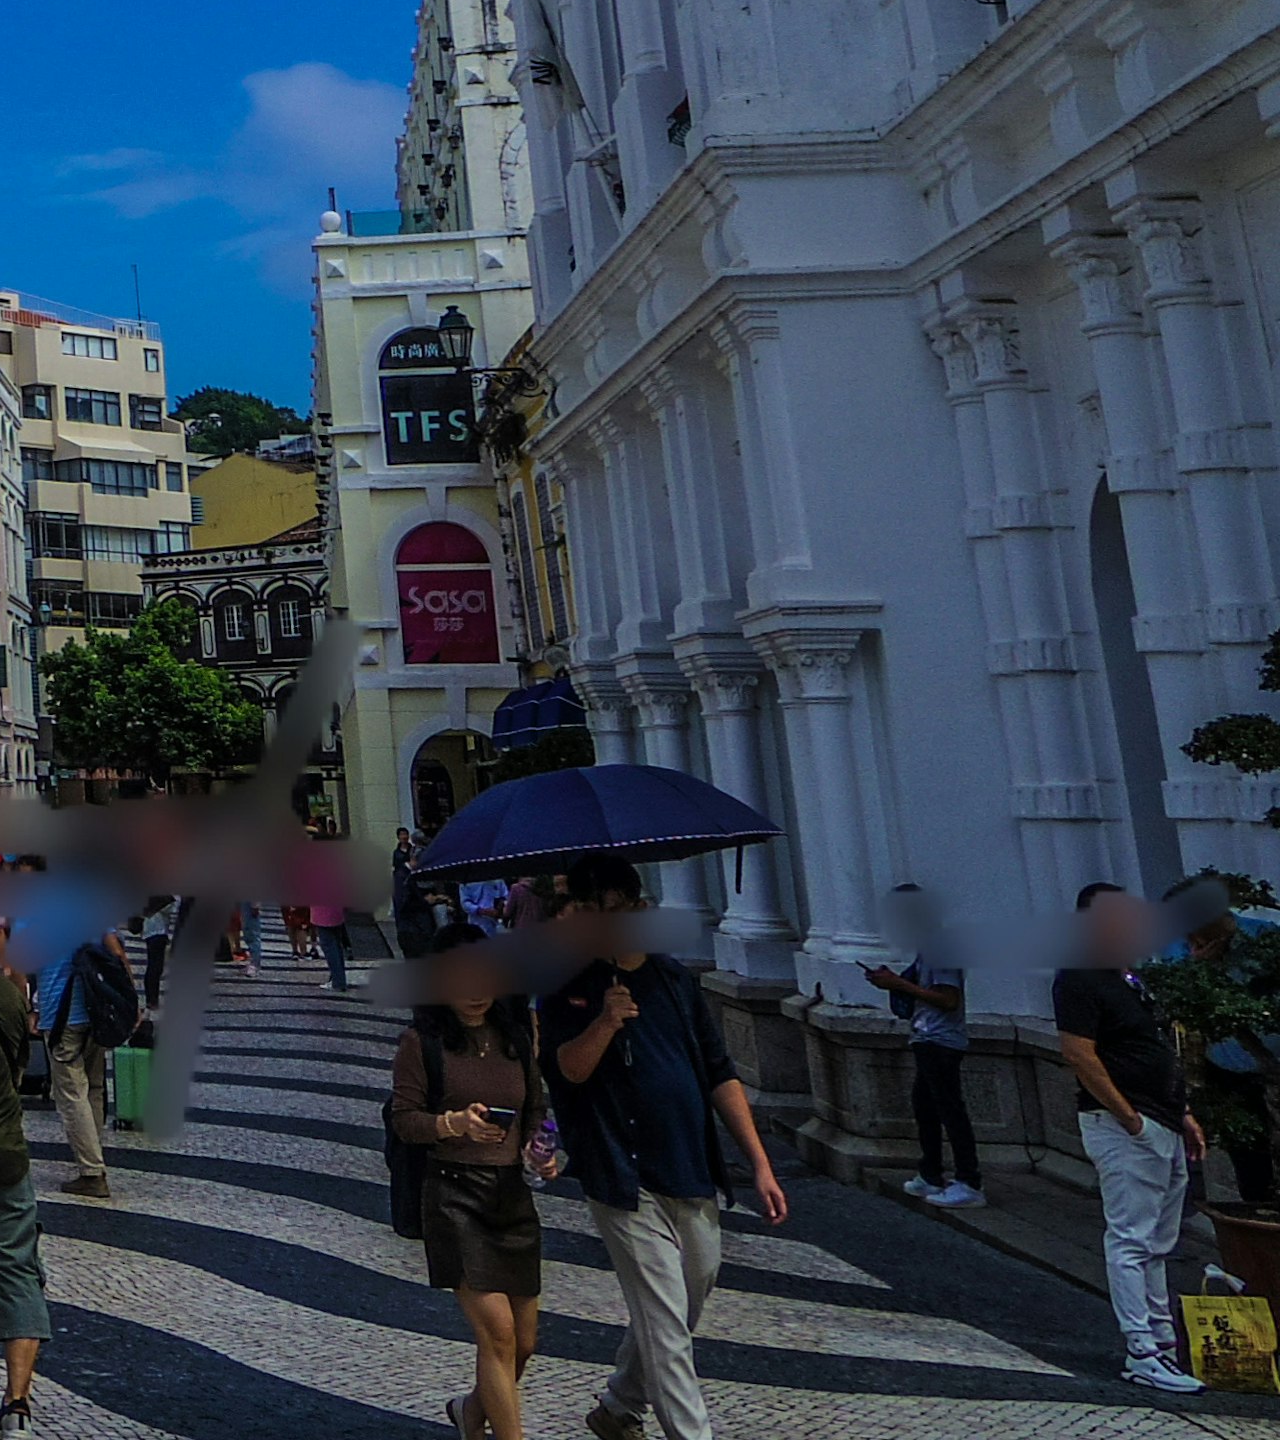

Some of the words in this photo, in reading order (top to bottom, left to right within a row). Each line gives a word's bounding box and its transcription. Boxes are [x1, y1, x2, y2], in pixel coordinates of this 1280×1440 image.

[390, 342, 446, 359] 時尚廣
[390, 409, 468, 443] TFS
